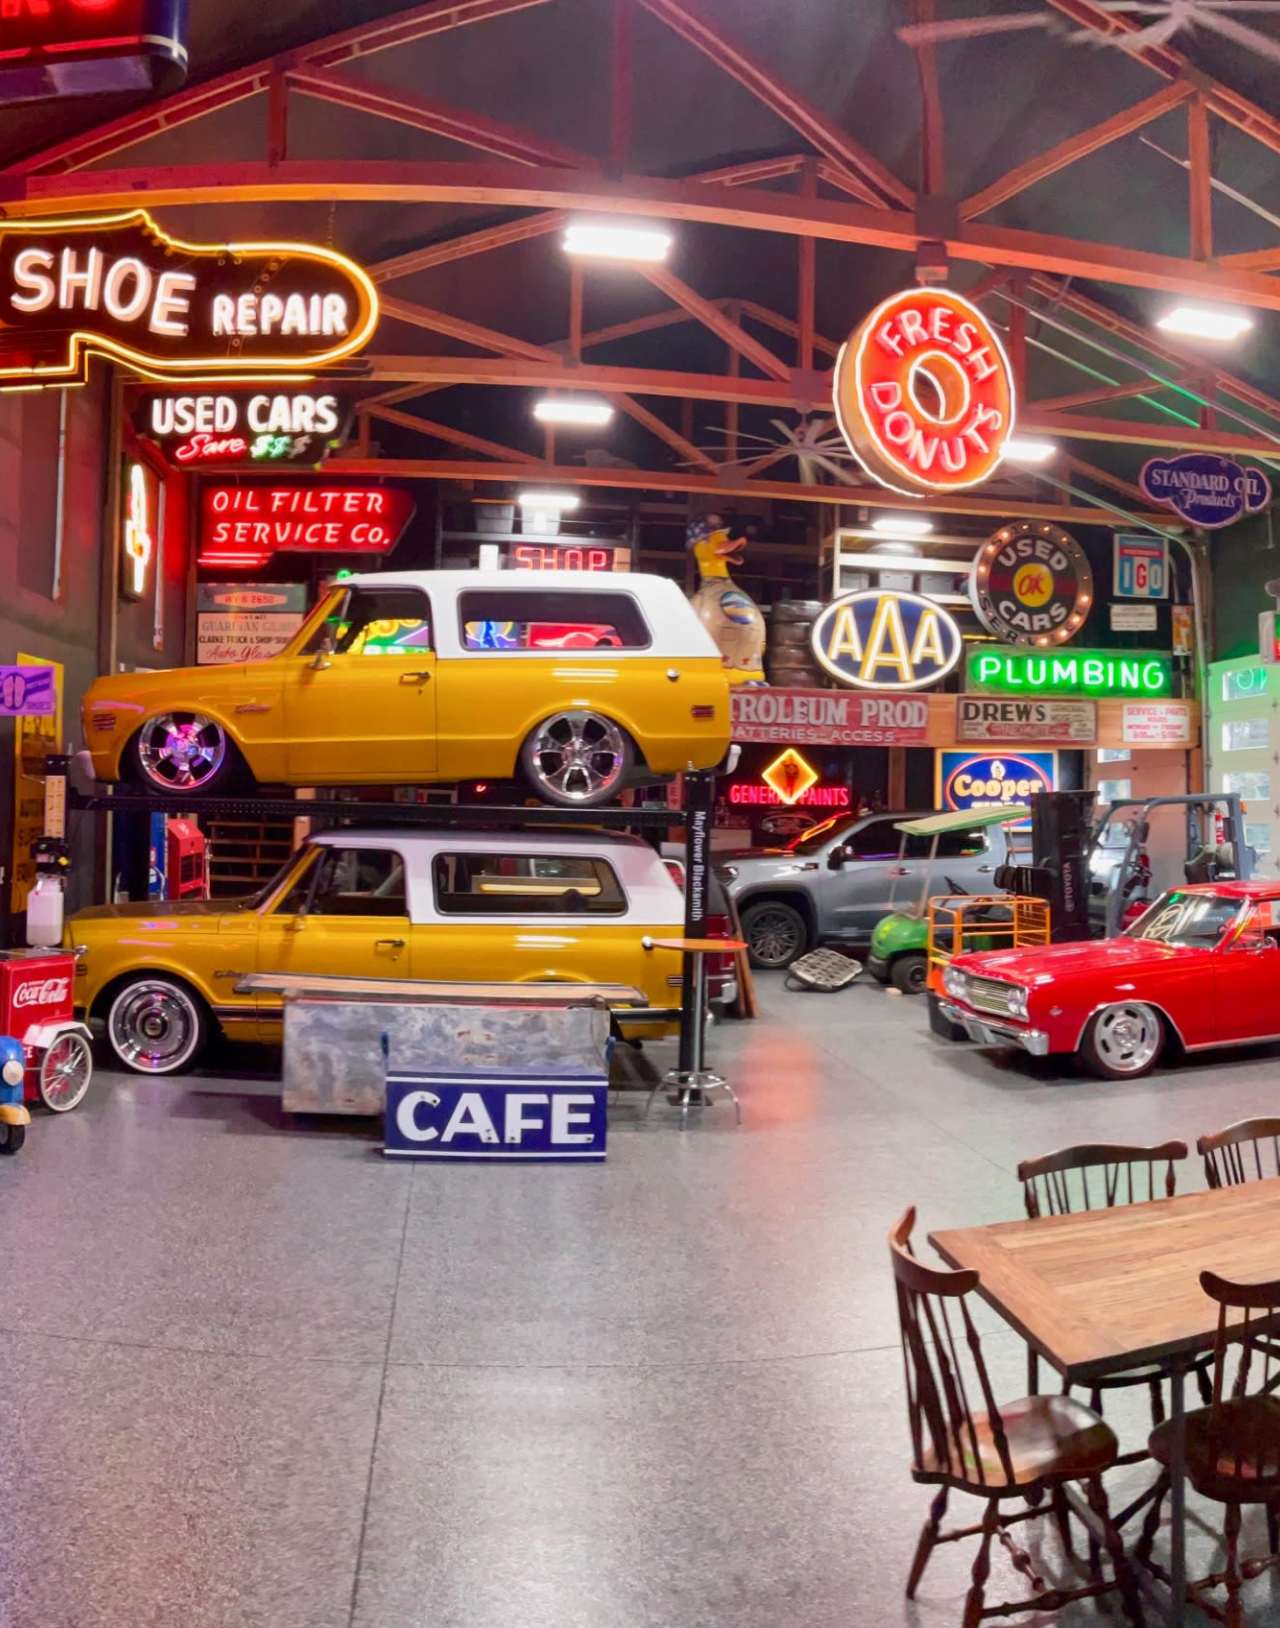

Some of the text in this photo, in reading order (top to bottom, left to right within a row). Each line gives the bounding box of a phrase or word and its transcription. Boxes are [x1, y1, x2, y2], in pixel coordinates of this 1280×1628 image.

[10, 246, 348, 337] SHOE REPAIR
[876, 307, 998, 382] FRESH
[152, 395, 338, 435] USED CARS
[870, 380, 1003, 472] DONUTS
[175, 436, 247, 462] Save
[1152, 469, 1261, 495] STANDARD OIL
[212, 491, 383, 513] OIL FILTER
[1181, 488, 1235, 509] Products
[212, 522, 391, 545] SERVICE Co.
[998, 539, 1068, 571] USED
[998, 600, 1068, 631] CARS
[829, 595, 945, 682] AAA
[979, 656, 1164, 689] PLUMBING
[861, 699, 928, 727] PROD
[963, 702, 1046, 722] DREWS
[730, 784, 849, 805] GENER PAINTS
[954, 774, 1043, 801] Cooper
[691, 811, 706, 921] Mayflower Blacksmith
[396, 1092, 595, 1144] CAFE
